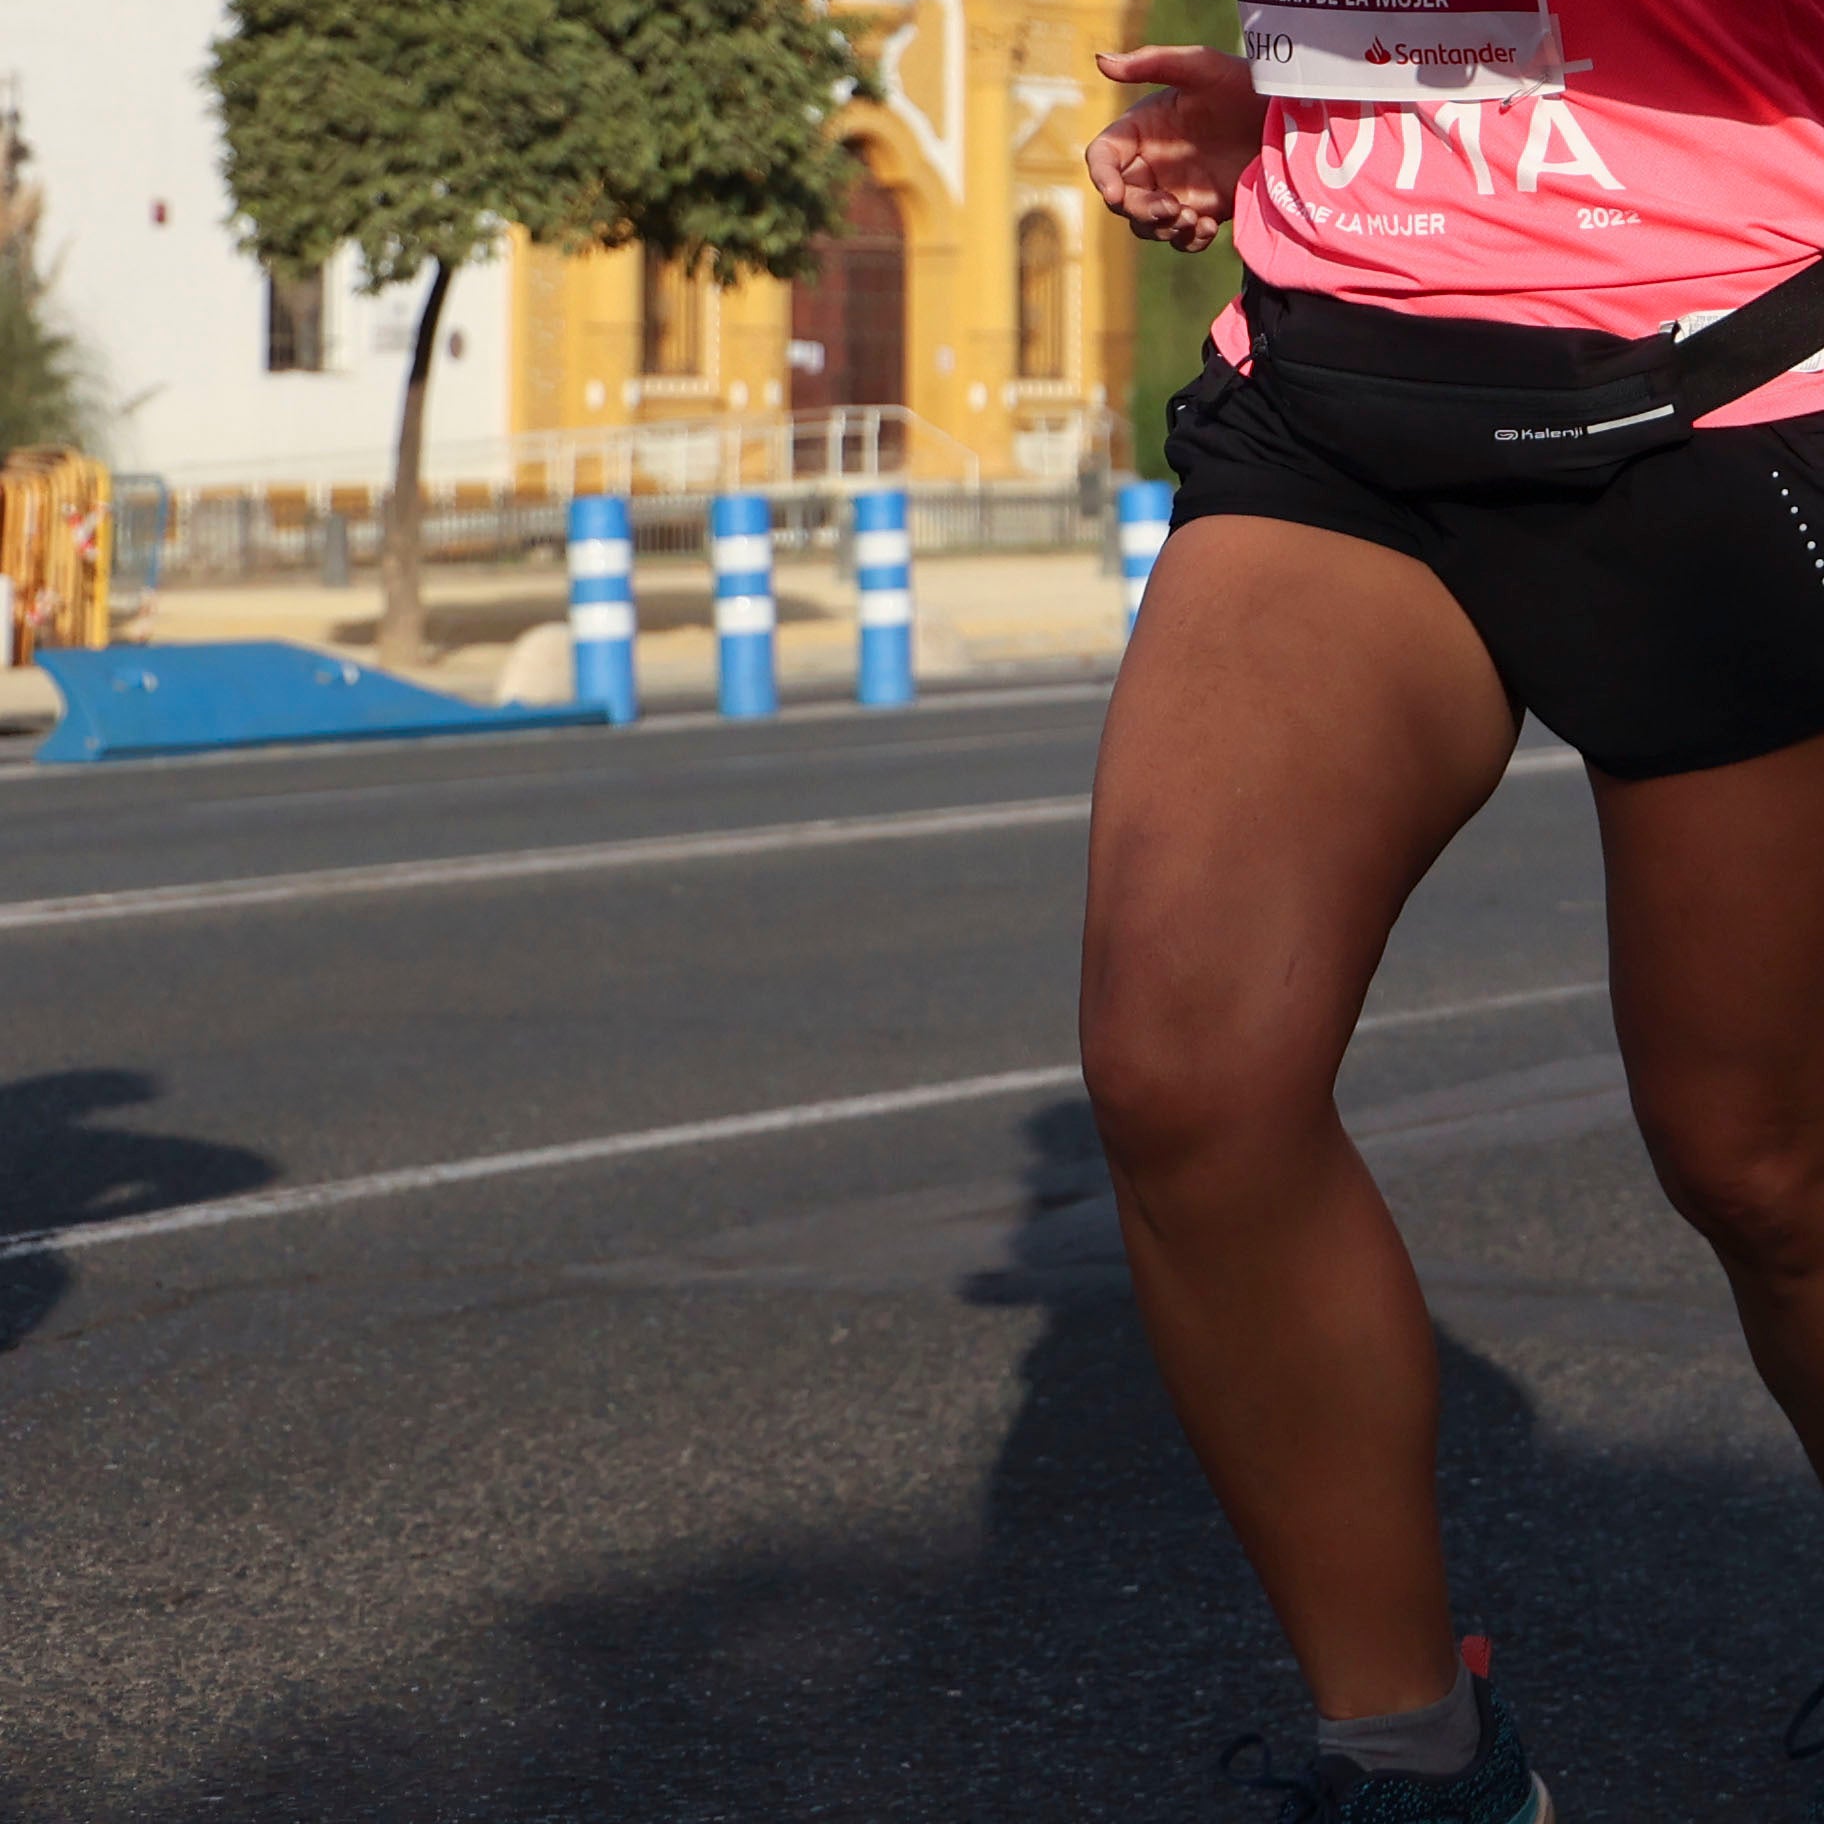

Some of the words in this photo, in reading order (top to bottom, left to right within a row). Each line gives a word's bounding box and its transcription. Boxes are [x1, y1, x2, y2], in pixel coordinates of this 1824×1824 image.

[1395, 41, 1517, 65] Santander
[1335, 213, 1363, 234] LA
[1367, 213, 1446, 236] MUJER
[1577, 207, 1642, 230] 2022
[1521, 426, 1583, 439] Kalenji
